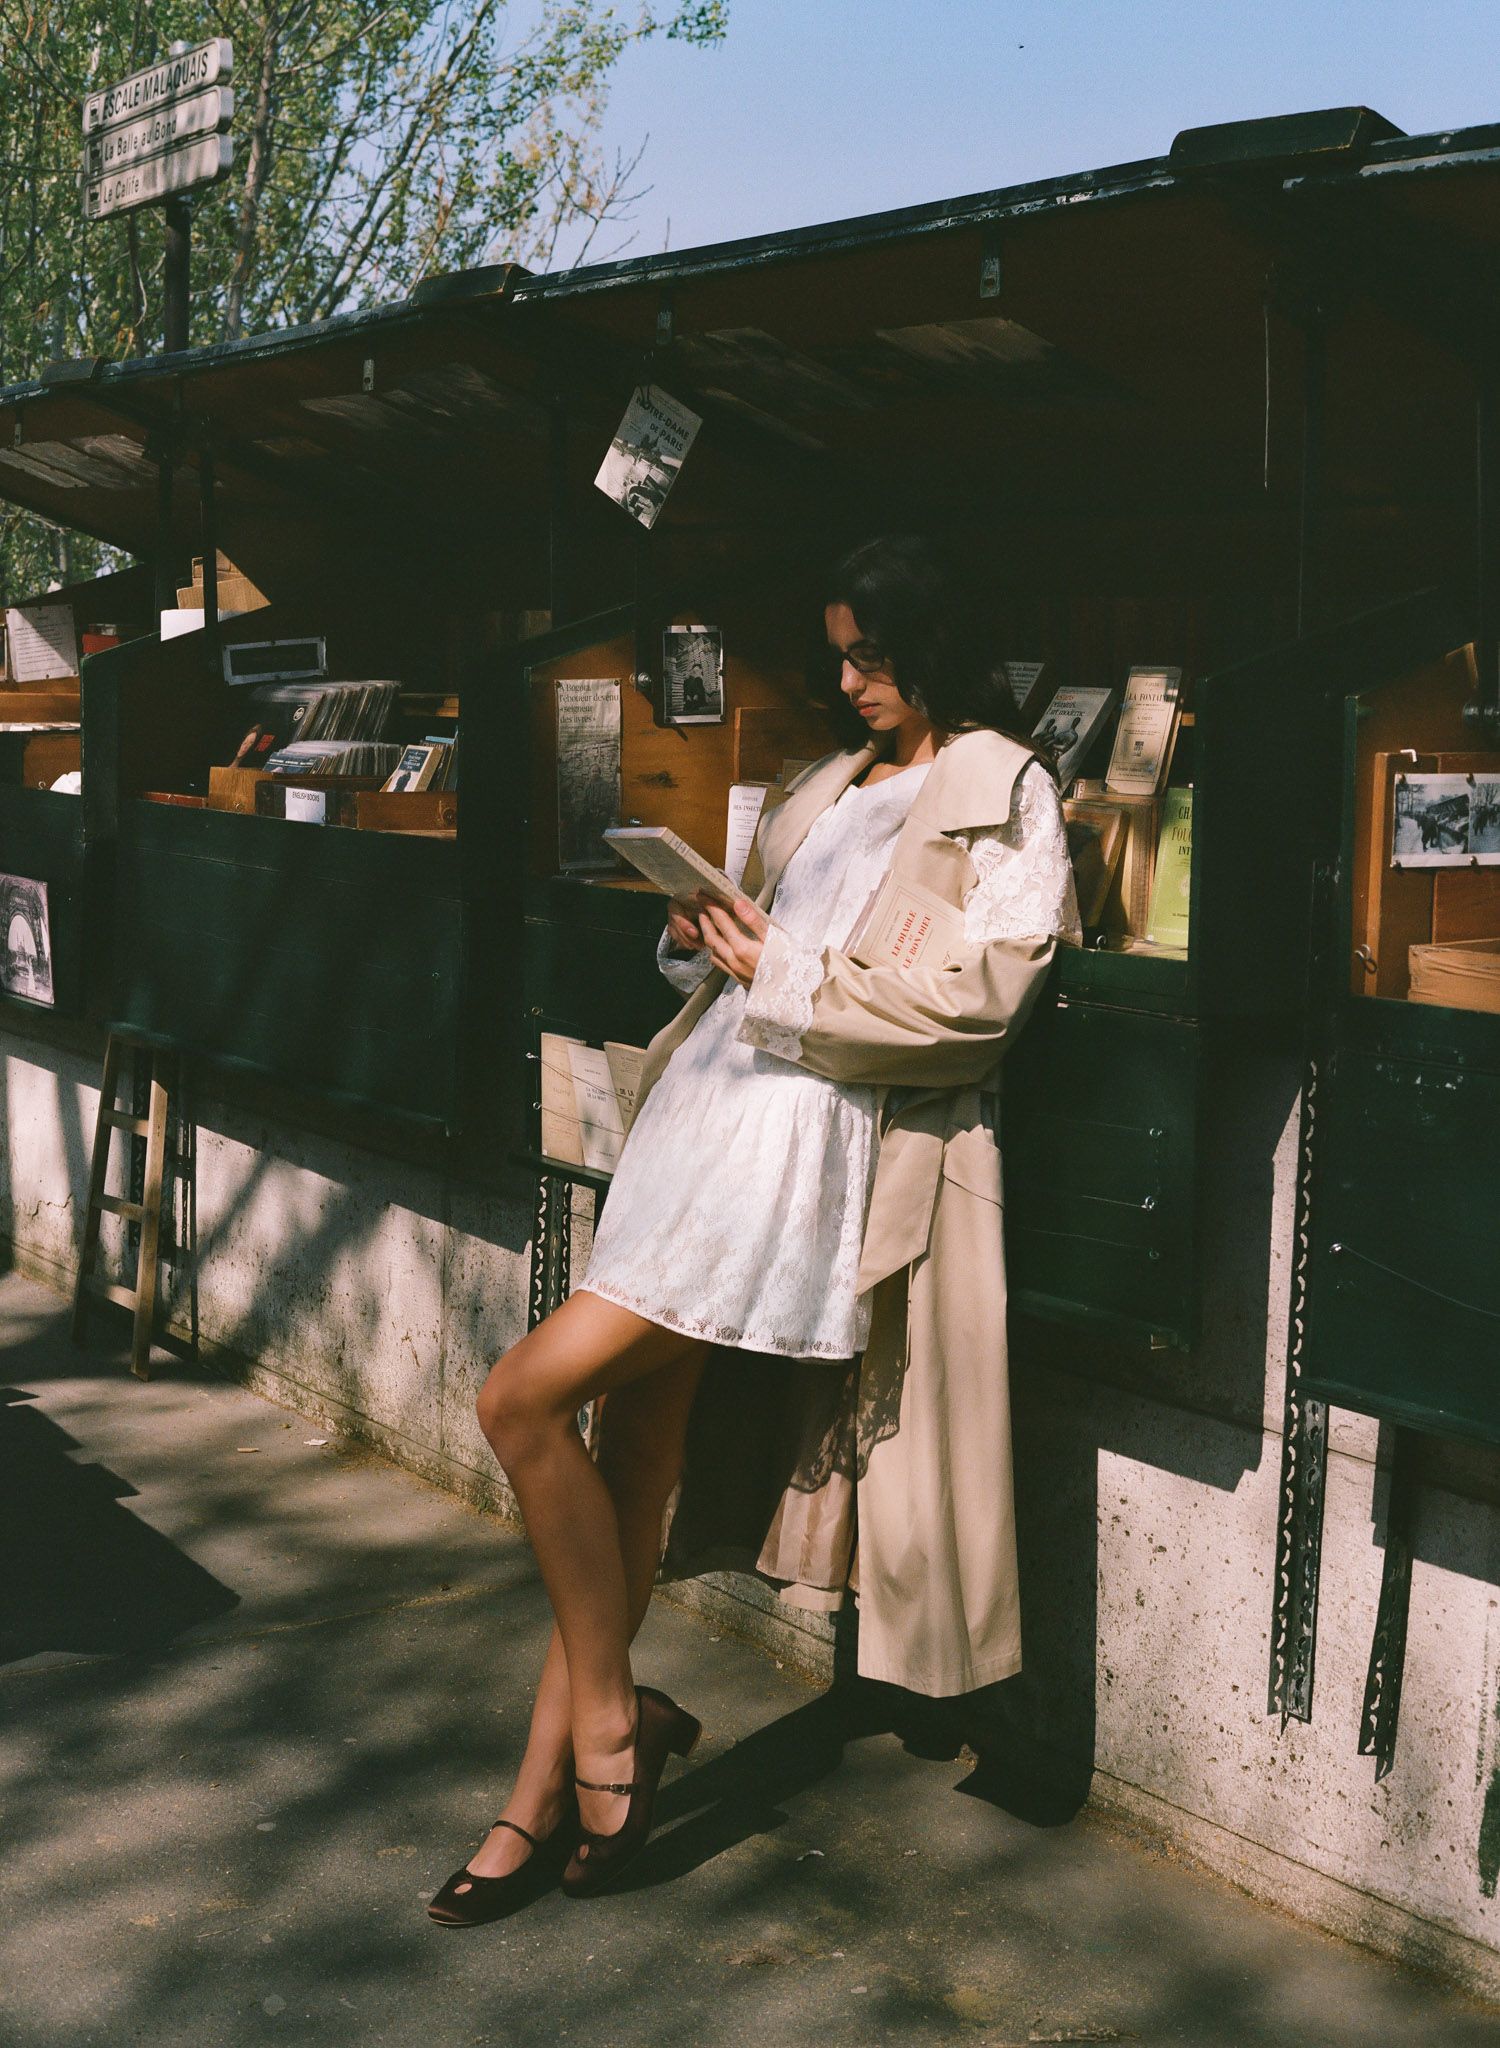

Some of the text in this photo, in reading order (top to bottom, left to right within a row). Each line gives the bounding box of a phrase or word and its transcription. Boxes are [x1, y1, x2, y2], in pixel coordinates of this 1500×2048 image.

[101, 52, 209, 121] ESCALE MALAQUAIS
[104, 142, 114, 161] La
[117, 132, 138, 156] Balle
[141, 130, 151, 146] au
[103, 176, 140, 204] Le Calife
[650, 422, 659, 434] DE
[660, 429, 684, 452] PARIS
[1139, 693, 1167, 702] FONTAI
[1178, 806, 1192, 820] CH
[891, 944, 902, 957] LE
[897, 910, 917, 946] DIABLE
[902, 956, 913, 969] LE
[908, 938, 922, 956] BON
